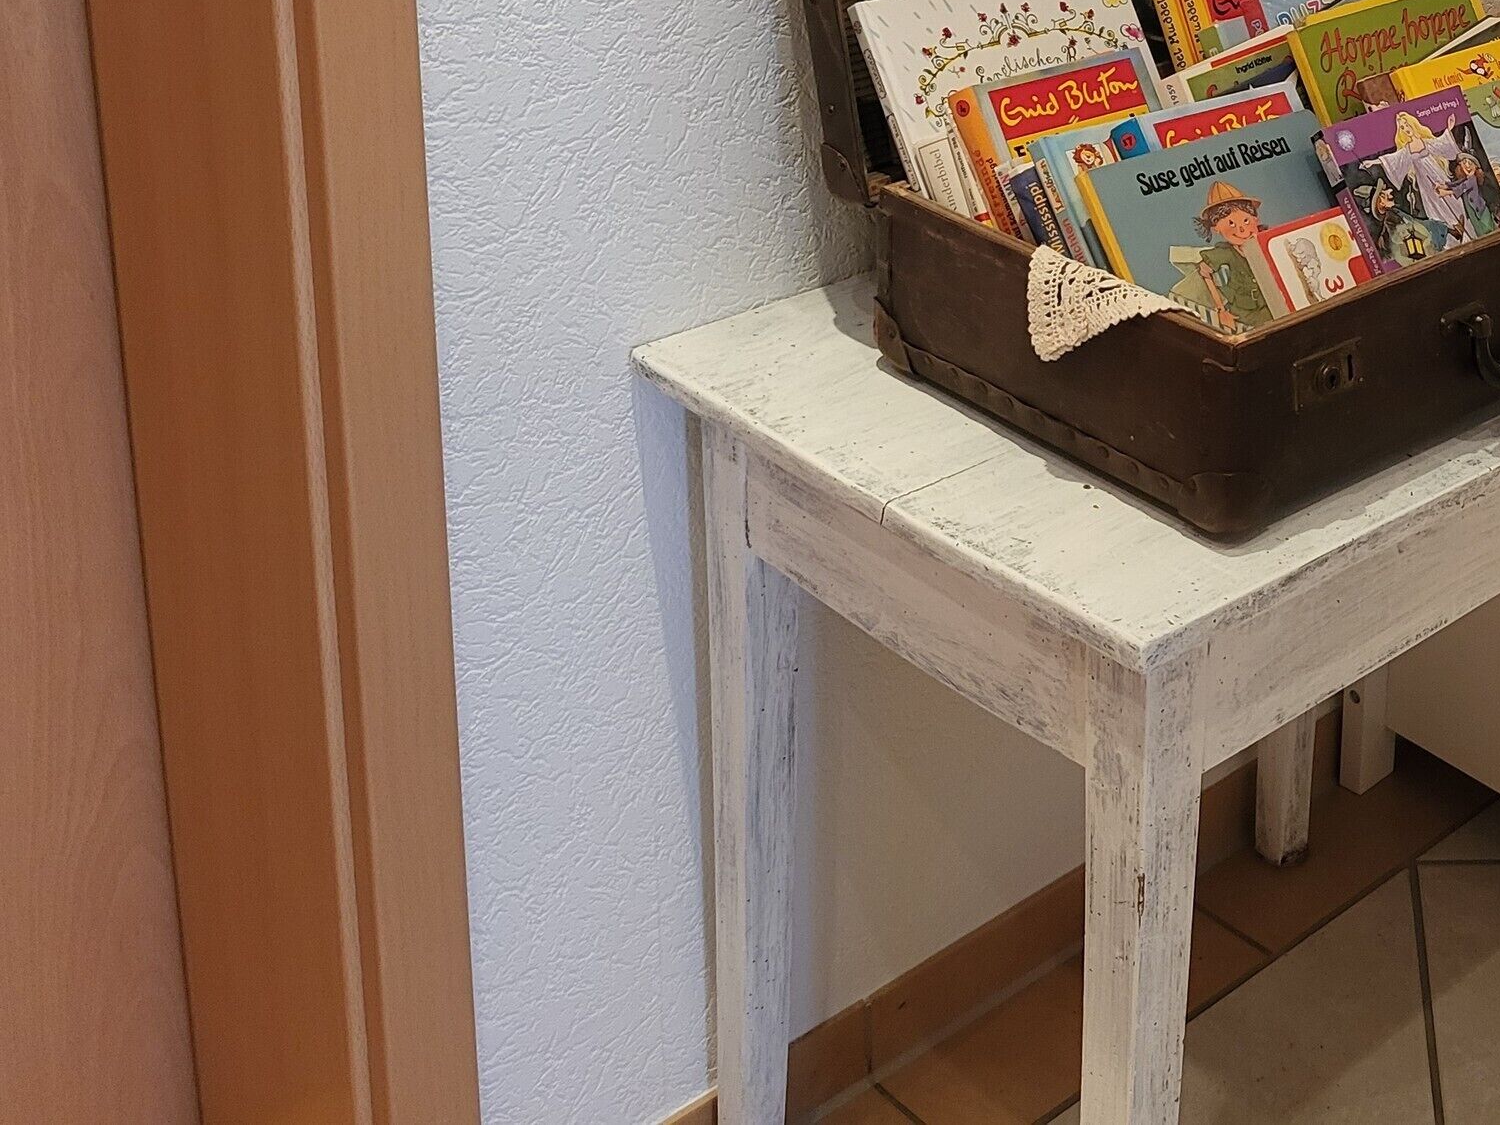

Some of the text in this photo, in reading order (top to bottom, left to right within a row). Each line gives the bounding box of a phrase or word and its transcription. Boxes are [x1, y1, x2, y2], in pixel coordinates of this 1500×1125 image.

[1000, 92, 1060, 127] Enid
[1057, 66, 1139, 111] Blyton
[1135, 168, 1180, 196] Suse
[1179, 153, 1216, 188] geht
[1213, 147, 1241, 173] auf
[1238, 136, 1291, 166] Reisen
[1026, 181, 1065, 254] Mississippi
[1324, 275, 1345, 293] 3
